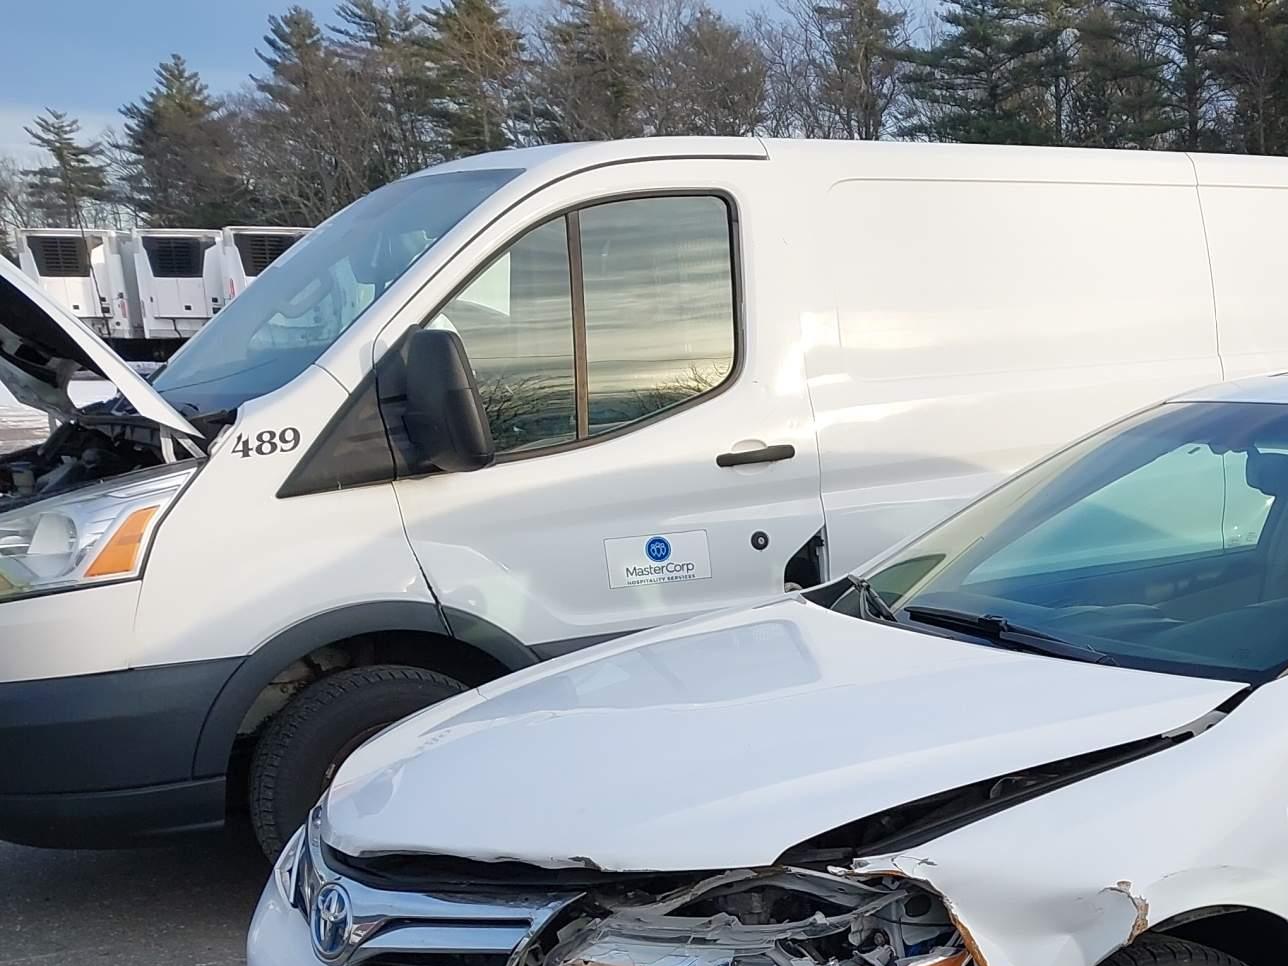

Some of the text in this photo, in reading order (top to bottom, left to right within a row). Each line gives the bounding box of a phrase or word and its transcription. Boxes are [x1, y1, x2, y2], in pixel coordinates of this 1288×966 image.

[231, 427, 301, 458] 489
[626, 562, 695, 578] MasterCorp
[627, 574, 695, 585] HOSPITALITY SERVICES
